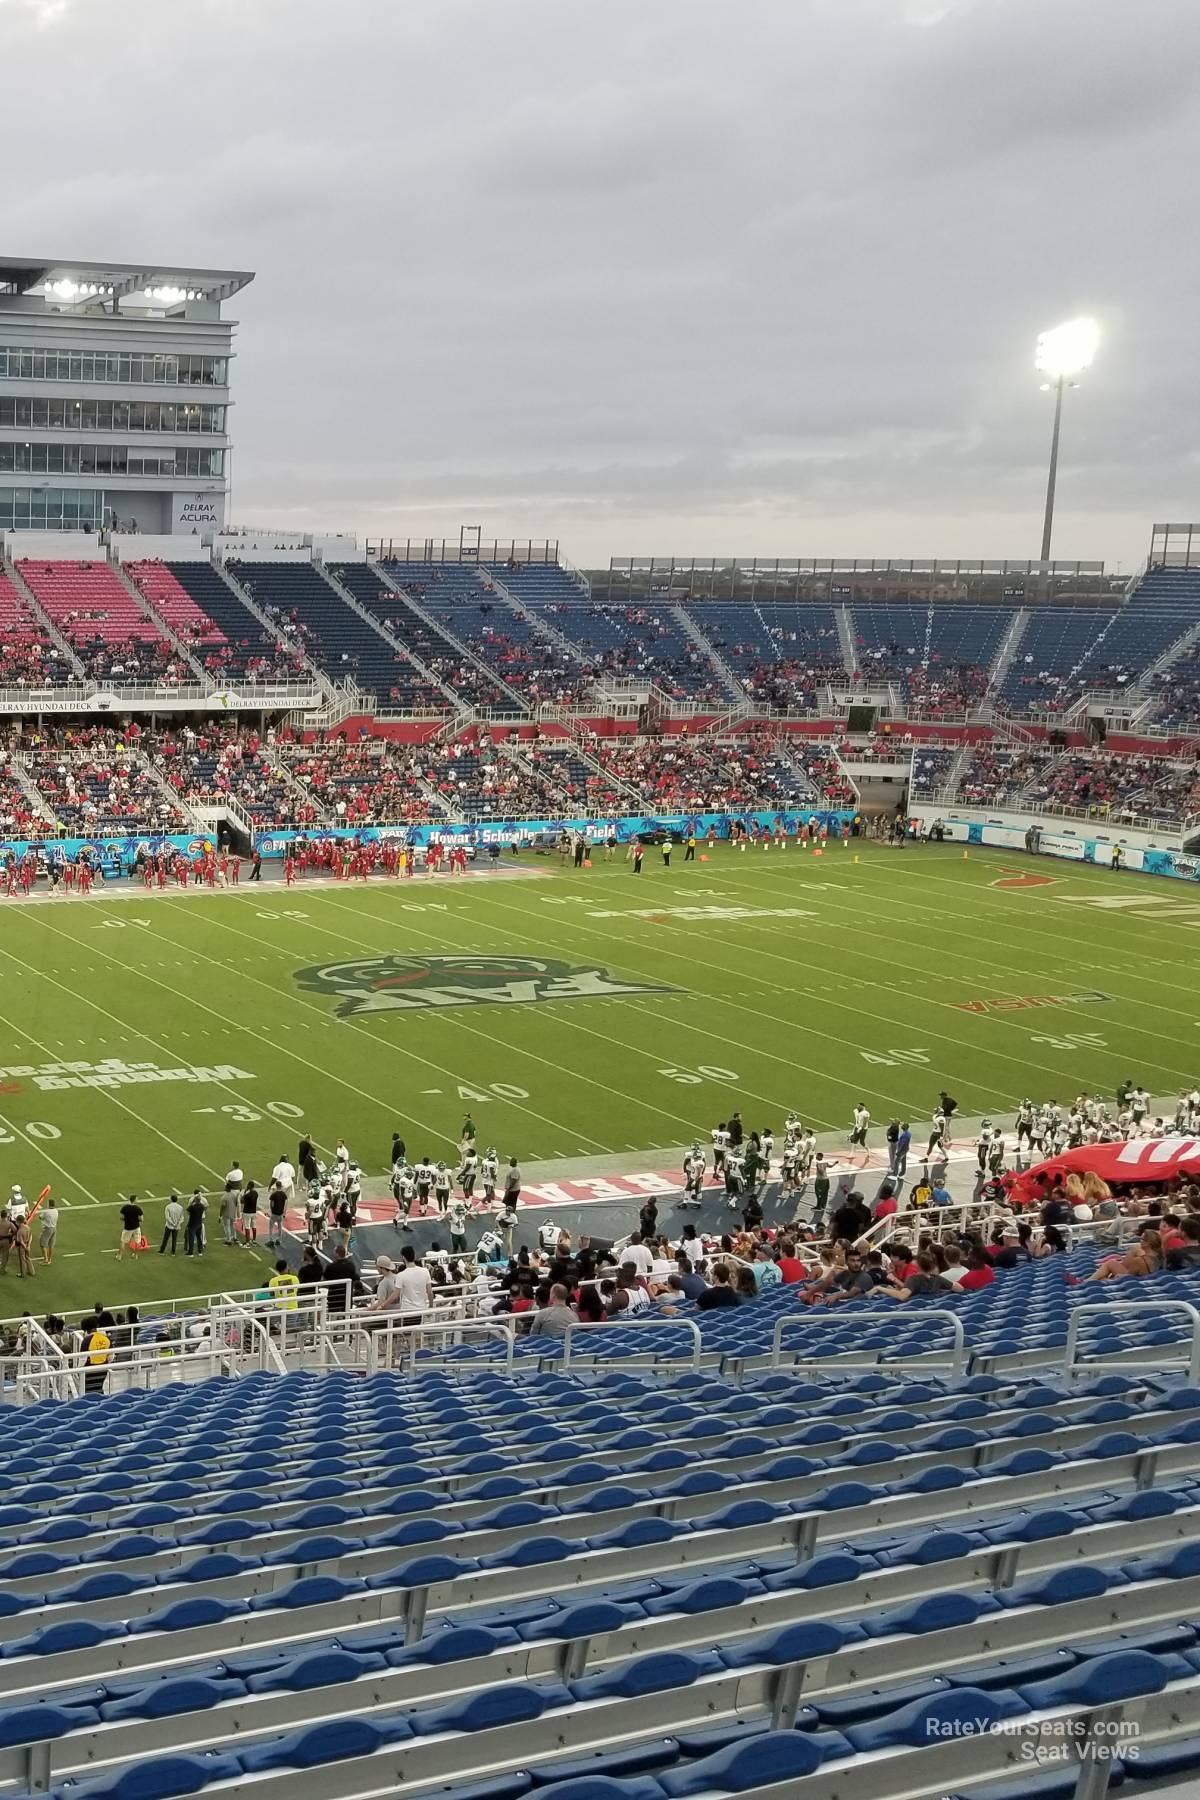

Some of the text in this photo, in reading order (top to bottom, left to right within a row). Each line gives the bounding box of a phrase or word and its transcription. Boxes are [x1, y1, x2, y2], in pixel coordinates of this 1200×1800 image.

[183, 503, 215, 512] DELRAY
[179, 514, 218, 522] ACURA
[27, 703, 67, 711] HYUNDAI
[69, 702, 93, 710] DECK
[586, 824, 617, 839] Field
[255, 910, 311, 920] 50
[102, 918, 152, 928] 40
[1031, 1033, 1108, 1050] 30
[860, 1049, 931, 1066] 40
[32, 1064, 258, 1091] Winning
[657, 1065, 740, 1084] 50
[457, 1083, 530, 1102] 40
[221, 1100, 305, 1122] 30
[418, 1170, 432, 1180] 93
[548, 1227, 555, 1238] 7
